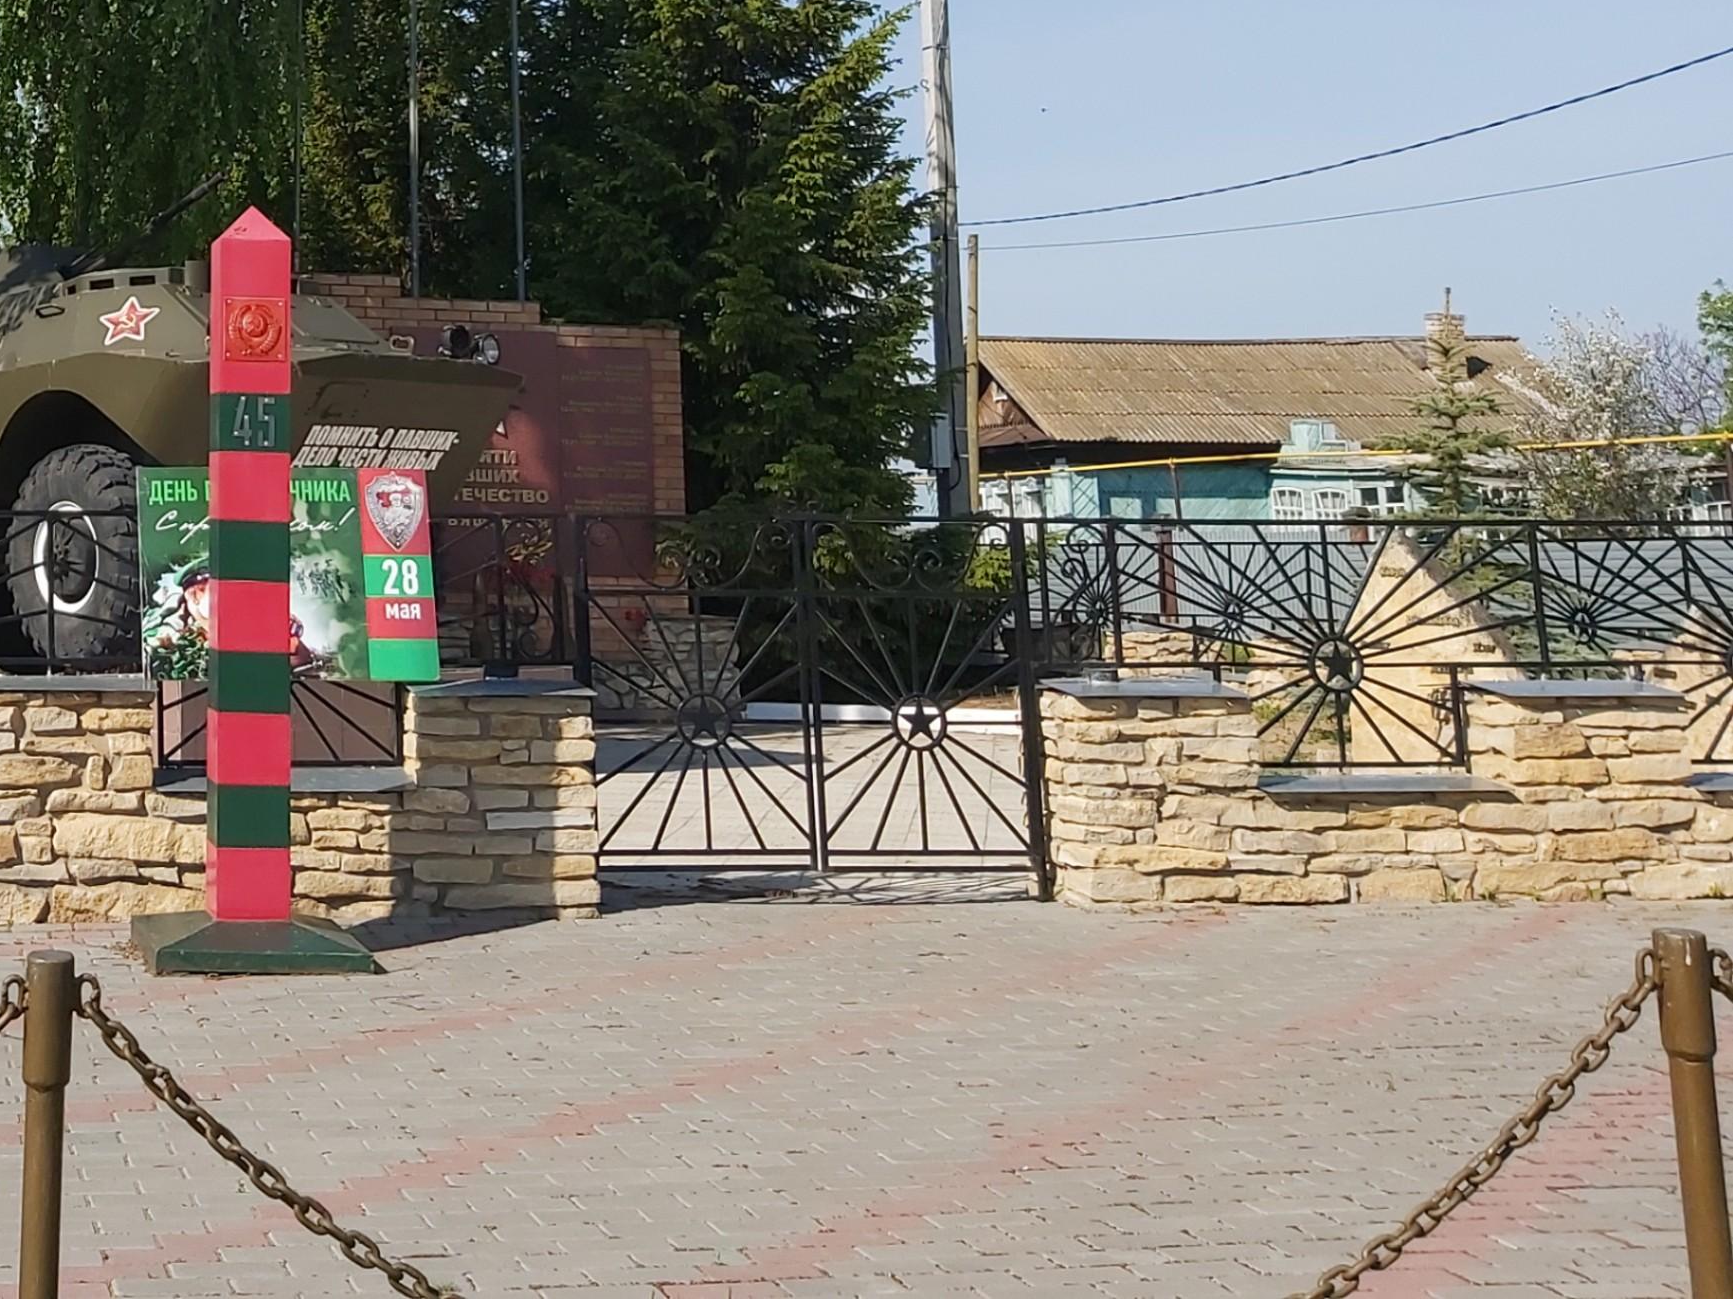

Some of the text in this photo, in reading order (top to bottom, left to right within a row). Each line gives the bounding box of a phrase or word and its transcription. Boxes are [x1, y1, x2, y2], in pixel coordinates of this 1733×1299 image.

[233, 396, 275, 447] 45
[304, 425, 379, 447] ПОМНИТЬ
[378, 428, 394, 448] О
[291, 446, 444, 470] ДЕЛО ЧЕСТИ ЖИВЫХ
[149, 480, 198, 505] ДЕНЬ
[382, 559, 419, 595] 28
[385, 603, 421, 620] мая
